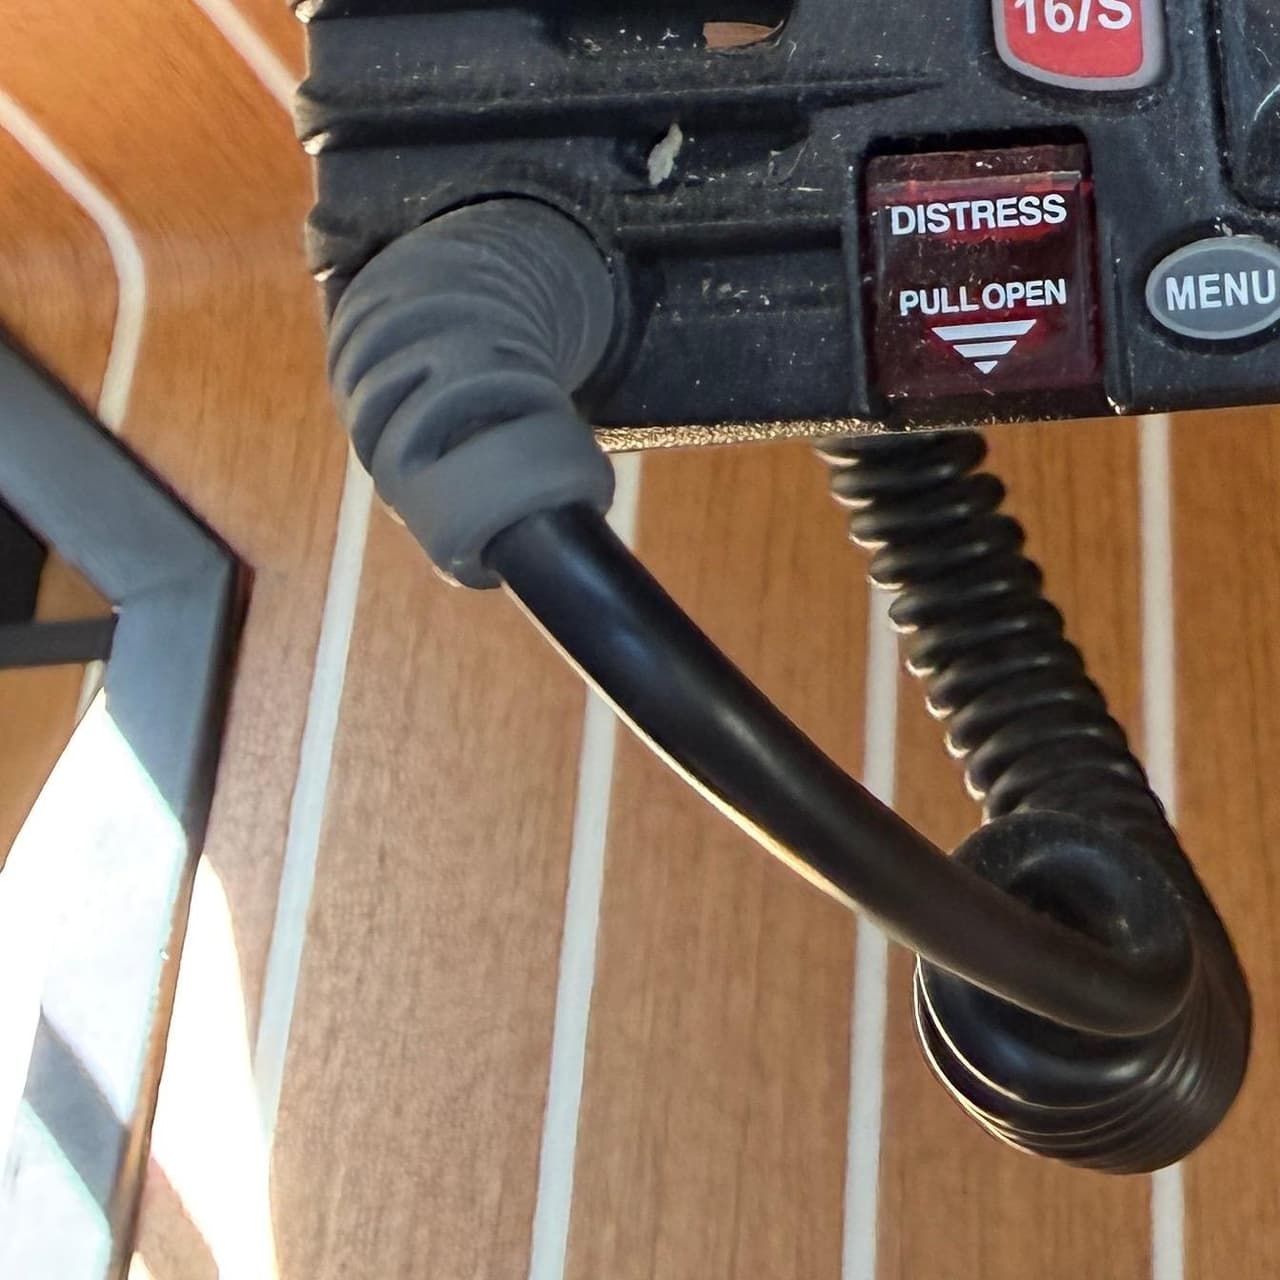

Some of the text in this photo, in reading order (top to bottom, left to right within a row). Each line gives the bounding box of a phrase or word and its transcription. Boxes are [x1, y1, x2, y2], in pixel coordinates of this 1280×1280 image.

[890, 193, 1068, 236] DISTRESS
[899, 277, 1068, 317] PULL OPEN
[1165, 268, 1277, 312] MENU
